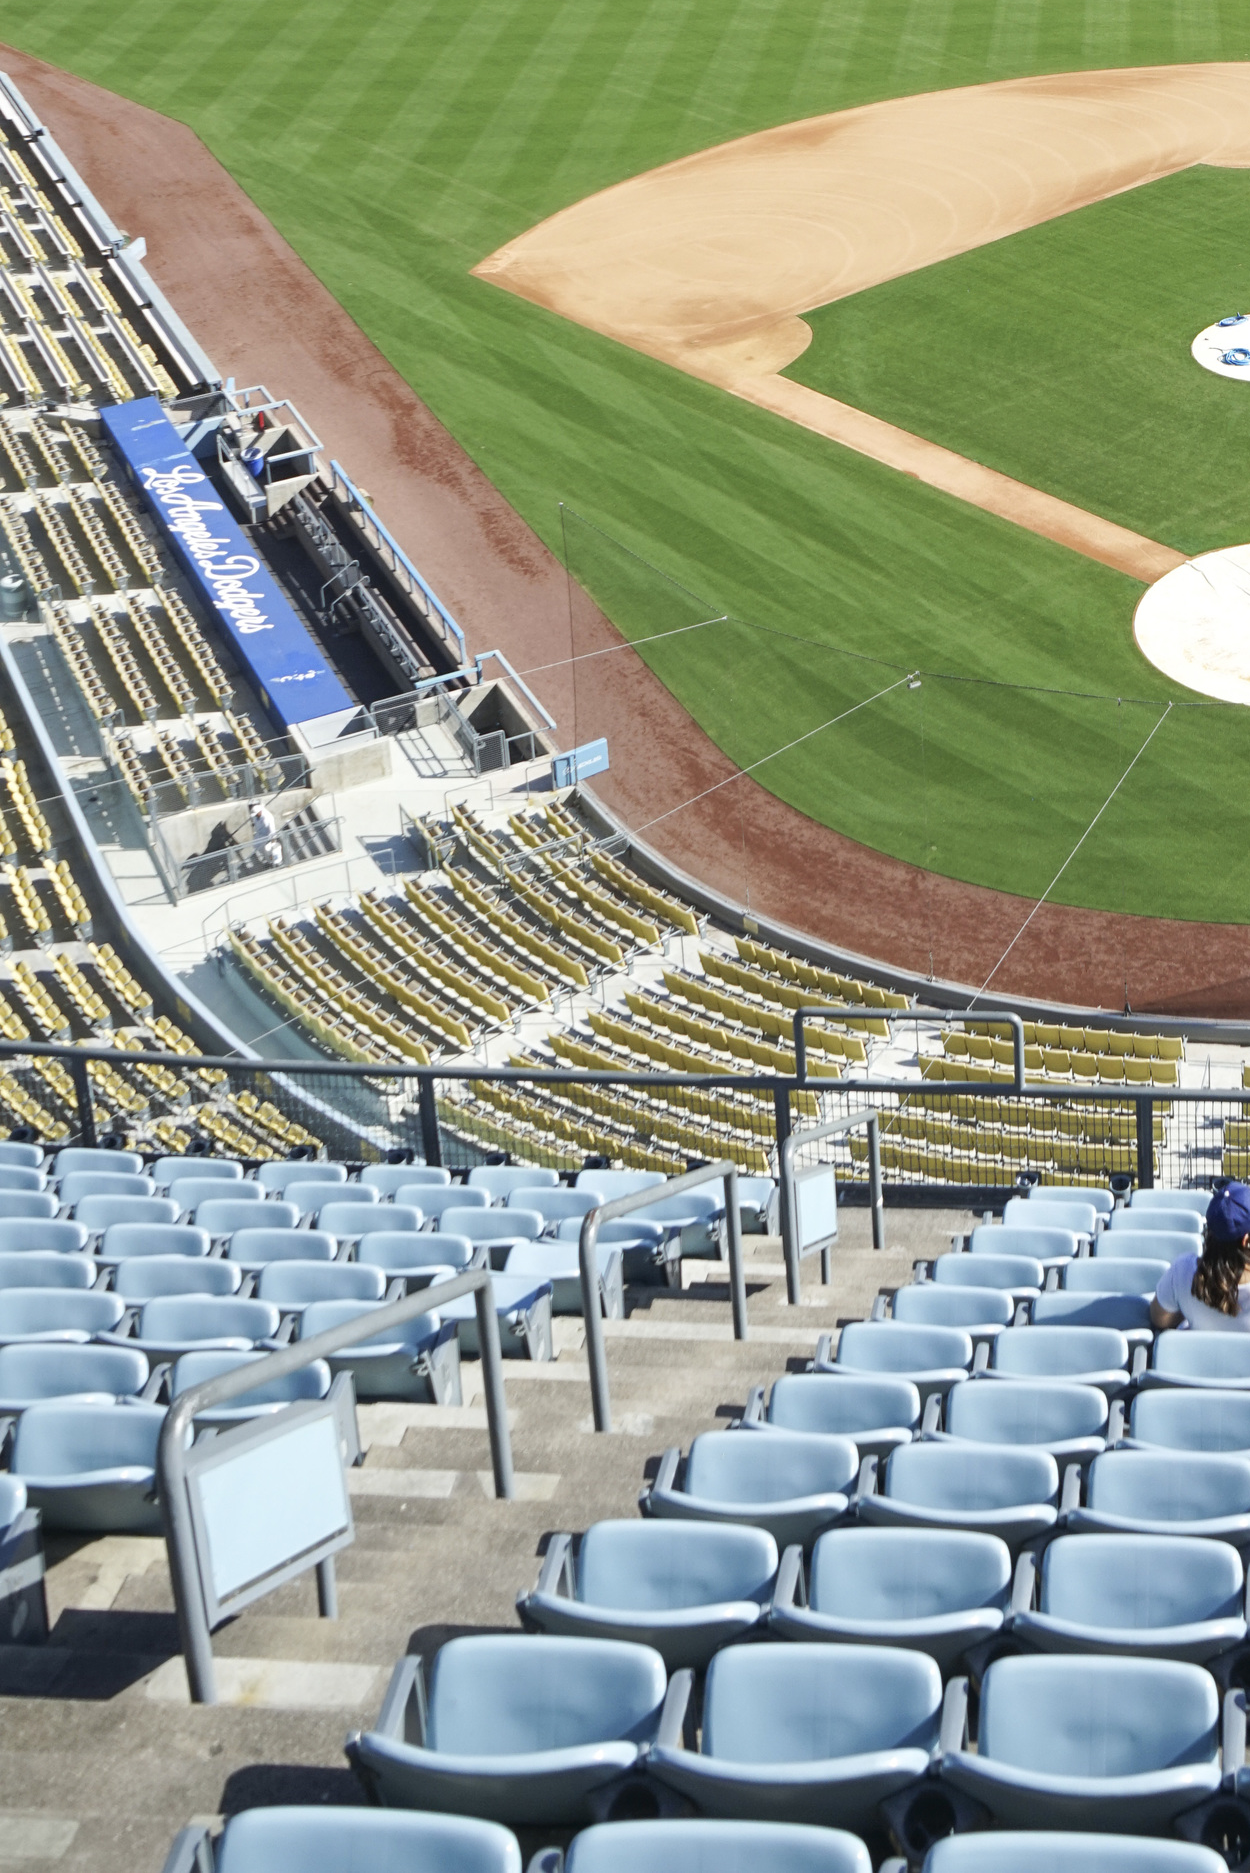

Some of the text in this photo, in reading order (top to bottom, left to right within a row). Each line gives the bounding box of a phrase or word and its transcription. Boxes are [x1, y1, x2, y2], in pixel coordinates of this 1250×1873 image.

[142, 465, 275, 634] Los Angeles Dodgers
